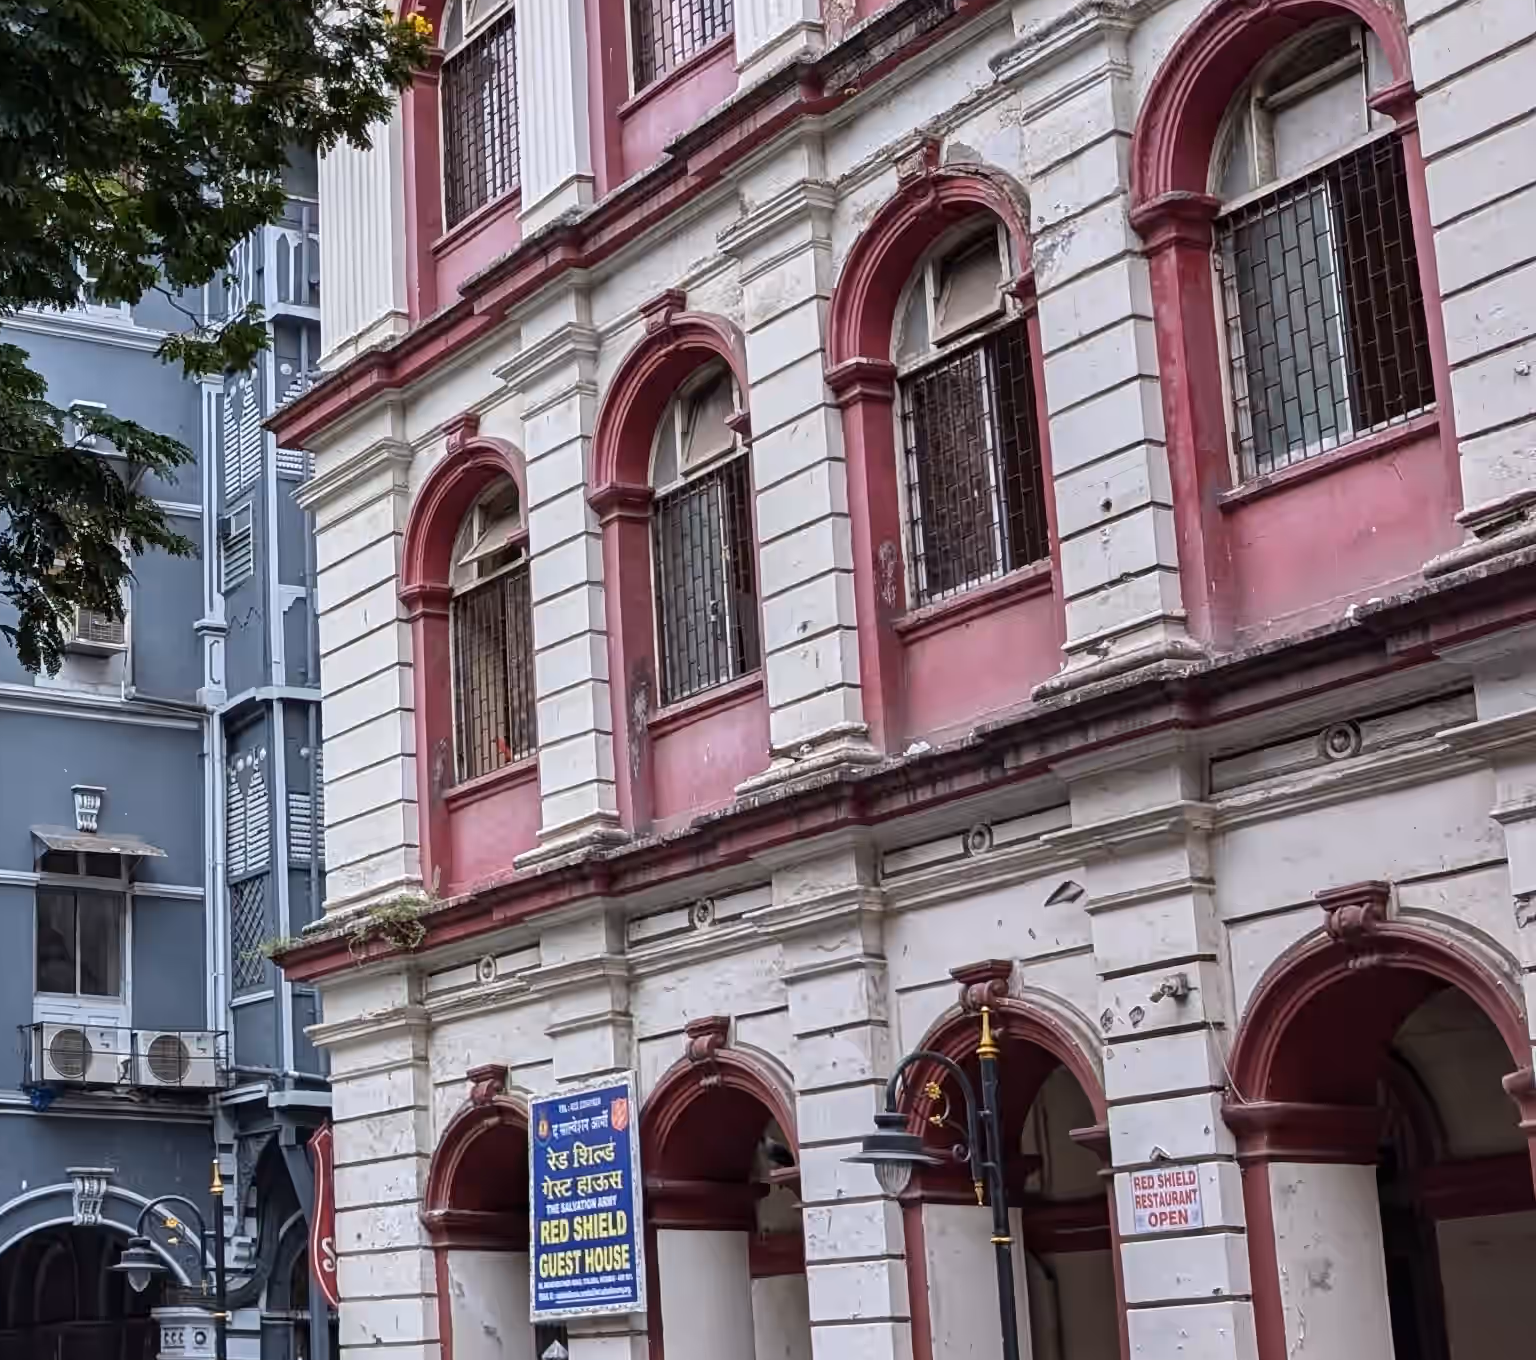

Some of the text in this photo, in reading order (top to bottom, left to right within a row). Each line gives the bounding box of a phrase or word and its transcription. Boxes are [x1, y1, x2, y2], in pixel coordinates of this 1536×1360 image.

[546, 1146, 570, 1171] रेड
[541, 1169, 623, 1200] गेस्ट हाऊस
[1133, 1170, 1196, 1191] RED SHIELD
[546, 1195, 618, 1215] THE SALVATION ARMY
[1135, 1188, 1198, 1210] RESTAURANT
[540, 1210, 627, 1246] RED SHIELD
[1148, 1208, 1189, 1228] OPEN
[539, 1244, 631, 1279] GUEST HOUSE
